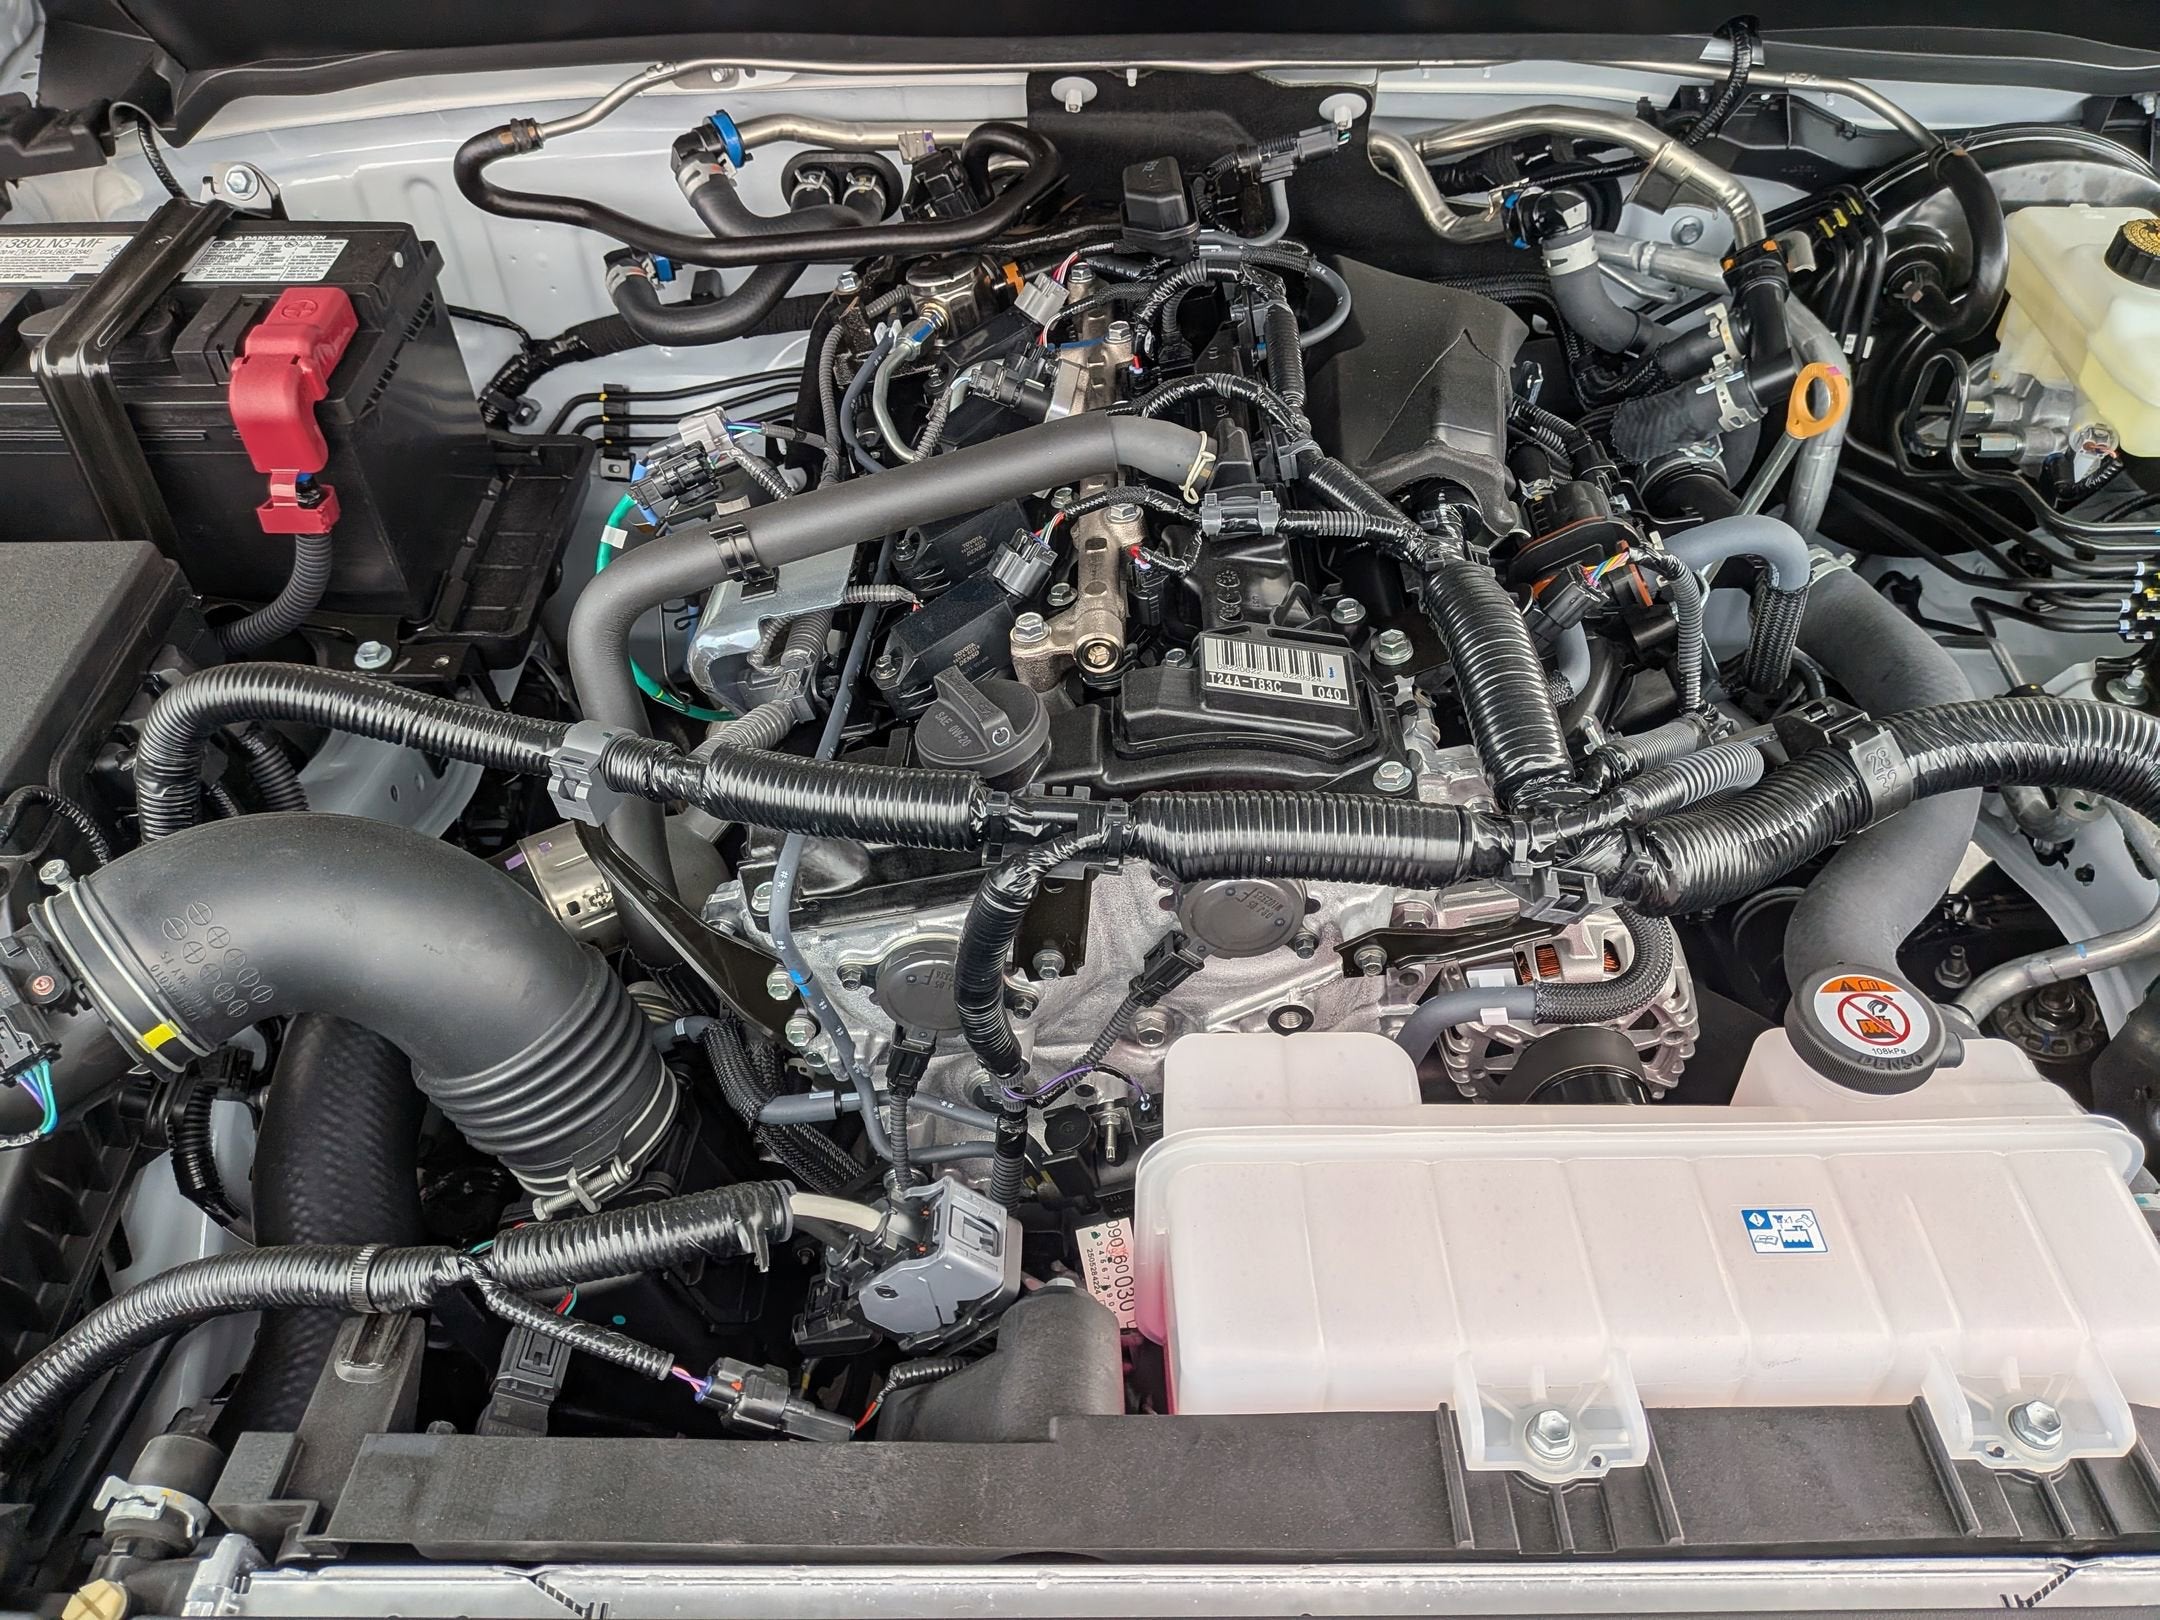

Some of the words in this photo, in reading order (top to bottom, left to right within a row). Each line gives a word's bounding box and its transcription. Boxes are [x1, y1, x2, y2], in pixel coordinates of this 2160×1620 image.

[6, 238, 106, 249] 380LN3-MF
[962, 535, 983, 548] TOYOTA
[967, 543, 986, 557] DENSO
[953, 642, 976, 657] TOYOTA
[959, 650, 980, 667] DENSO
[1209, 672, 1282, 693] T24A-T83C
[1317, 686, 1342, 700] 040
[934, 711, 953, 727] SAE
[948, 725, 972, 747] 0W-20
[1866, 746, 1893, 775] 28
[1876, 768, 1904, 798] 32
[1871, 1046, 1907, 1055] 108kPa
[1857, 1054, 1924, 1071] DENSO
[1086, 1248, 1102, 1295] 2505284224
